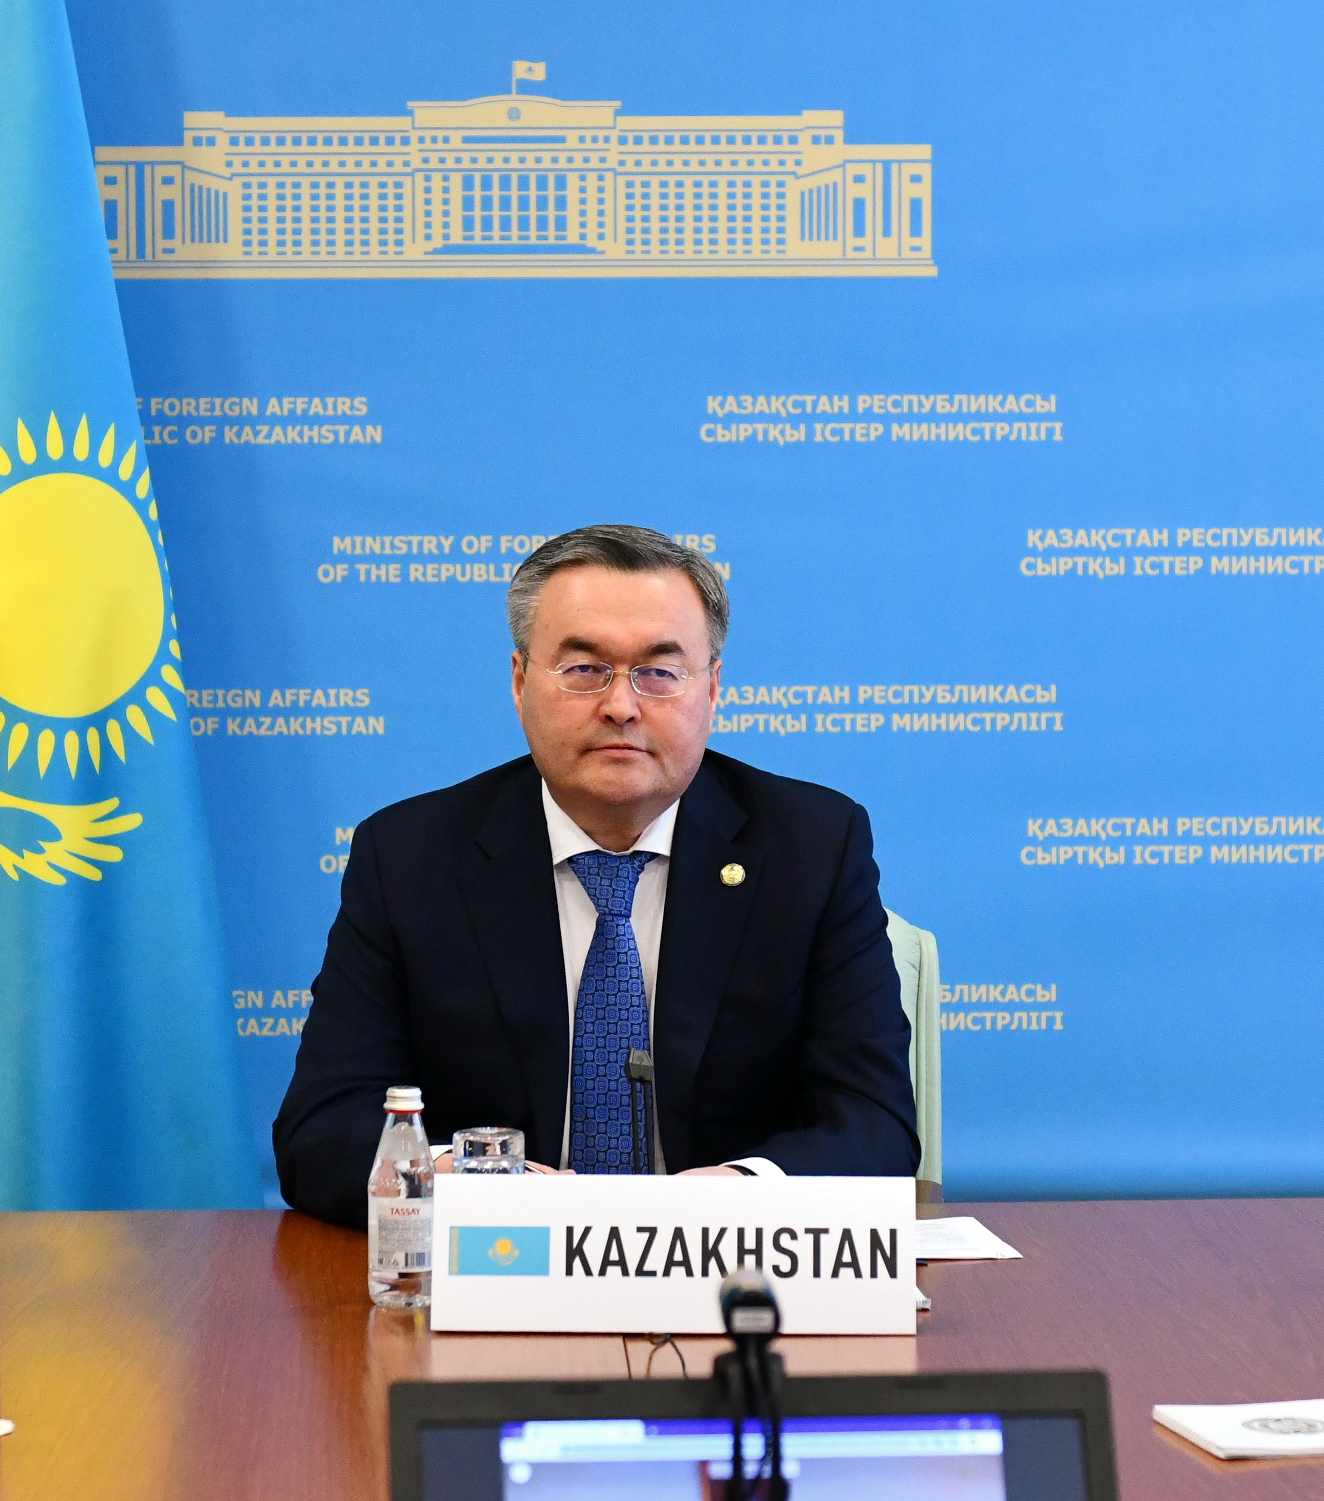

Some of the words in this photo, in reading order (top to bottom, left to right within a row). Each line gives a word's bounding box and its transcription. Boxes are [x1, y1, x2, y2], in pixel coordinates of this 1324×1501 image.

[150, 396, 260, 417] FOREIGN
[265, 396, 369, 417] AFFAIRS
[706, 393, 850, 418] ҚАЗАҚСТАН
[857, 393, 1057, 415] РЕСПУБЛИКАСЫ
[185, 425, 217, 445] OF
[224, 424, 383, 445] KAZAKHSTAN
[699, 422, 807, 446] СЫРТҚЫ
[332, 535, 455, 555] MINISTRY
[460, 534, 493, 555] OF
[1027, 527, 1170, 551] ҚАЗАҚСТАН
[317, 563, 350, 584] OF
[355, 563, 402, 583] THE
[1019, 556, 1127, 580] СЫРТҚЫ
[185, 688, 262, 709] REIGN
[268, 687, 371, 708] AFFAIRS
[858, 683, 1058, 705] РЕСПУБЛИКАСЫ
[190, 716, 220, 737] OF
[227, 715, 386, 736] KAZAKHSTAN
[1027, 817, 1170, 840] ҚАЗАҚСТАН
[1020, 845, 1127, 869] СЫРТҚЫ
[389, 1207, 421, 1216] TASSAY
[564, 1225, 898, 1280] KAZAKHSTAN
